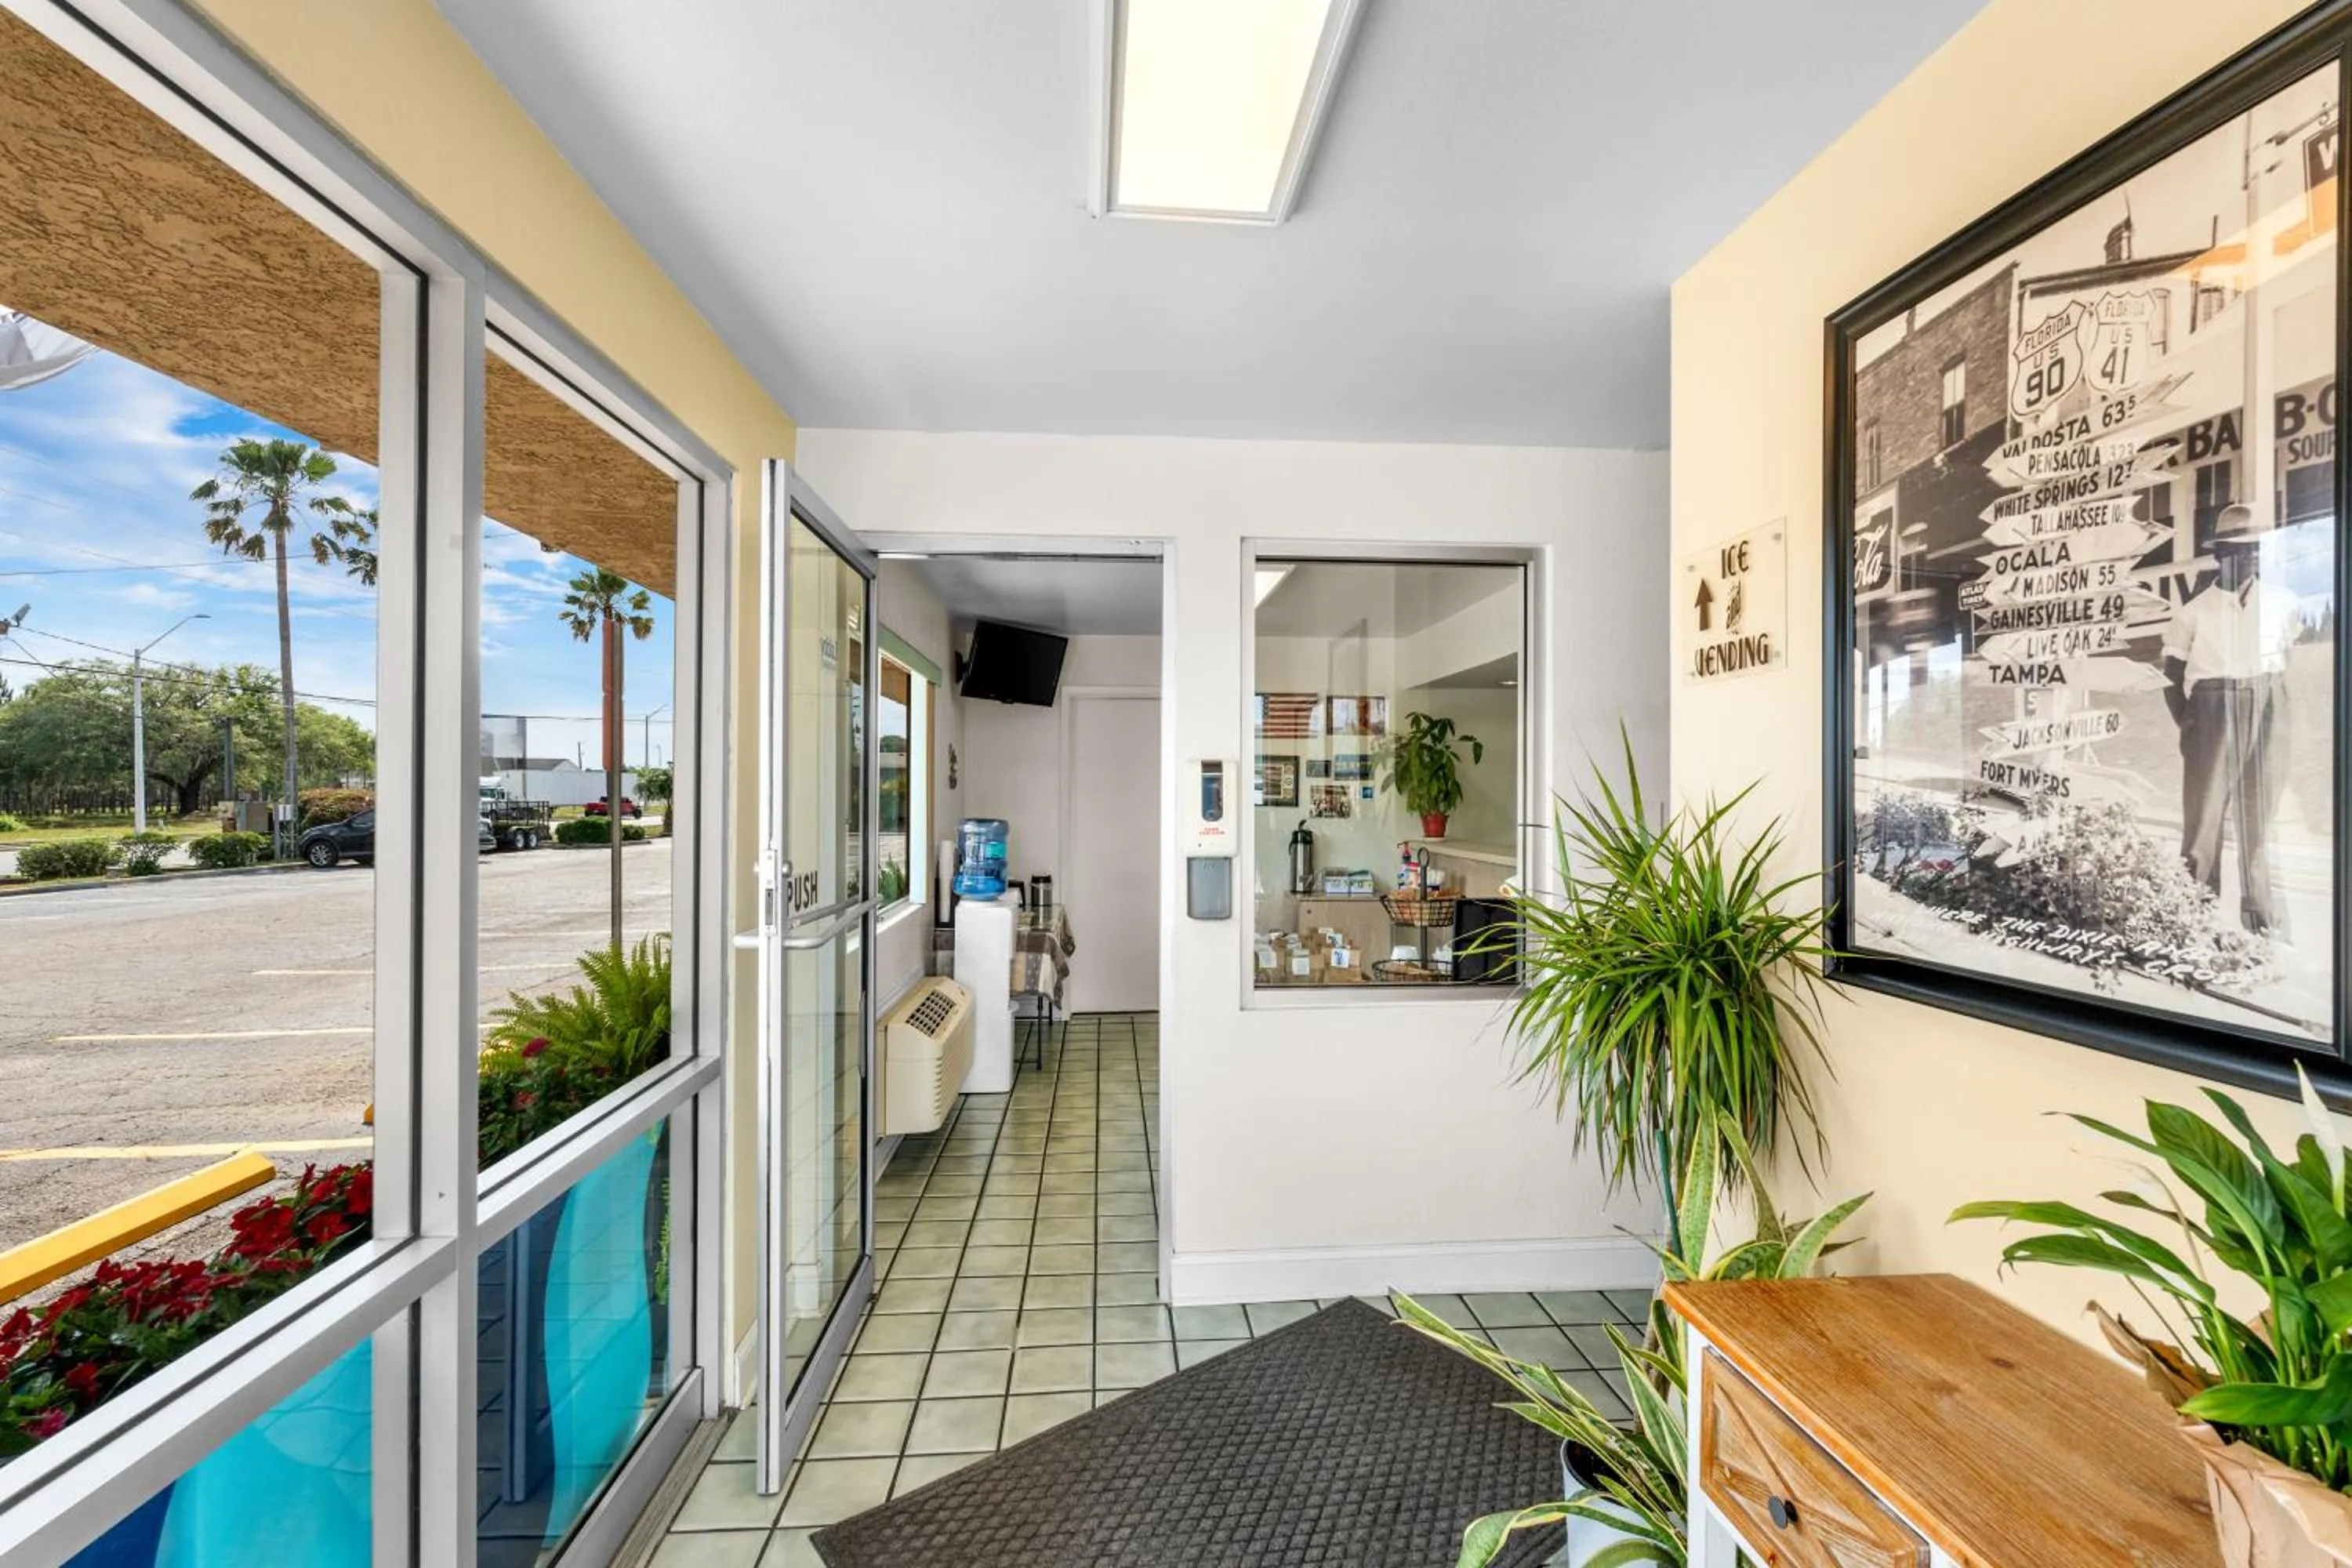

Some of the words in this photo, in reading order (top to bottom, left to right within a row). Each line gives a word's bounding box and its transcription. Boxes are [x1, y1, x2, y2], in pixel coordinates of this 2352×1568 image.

[2024, 312, 2071, 353] FLORIDA
[2025, 357, 2065, 408] 90
[2100, 346, 2129, 384] 41
[2028, 445, 2101, 476] PENSACOLA
[1993, 492, 2031, 521] WHITE
[2033, 470, 2100, 510] SPRINGS
[1721, 540, 1749, 579] ICE
[1995, 542, 2071, 575] OCALA
[2023, 568, 2089, 598] MADISON
[2098, 564, 2116, 586] 55
[1990, 598, 2094, 630] GAINESVILLE
[2100, 594, 2125, 619] 49
[1695, 633, 1769, 677] VENDING
[2027, 633, 2058, 659] LIVE
[2063, 629, 2092, 653] OAK
[1988, 664, 2067, 685] TAMPA
[2013, 714, 2103, 750] JACKSONVILLE
[2105, 712, 2120, 734] 60
[1980, 760, 2016, 785] FORT
[2019, 767, 2071, 798] MYERS
[786, 870, 818, 917] PUSH
[2001, 916, 2046, 934] THE
[2048, 924, 2123, 947] DIXIE
